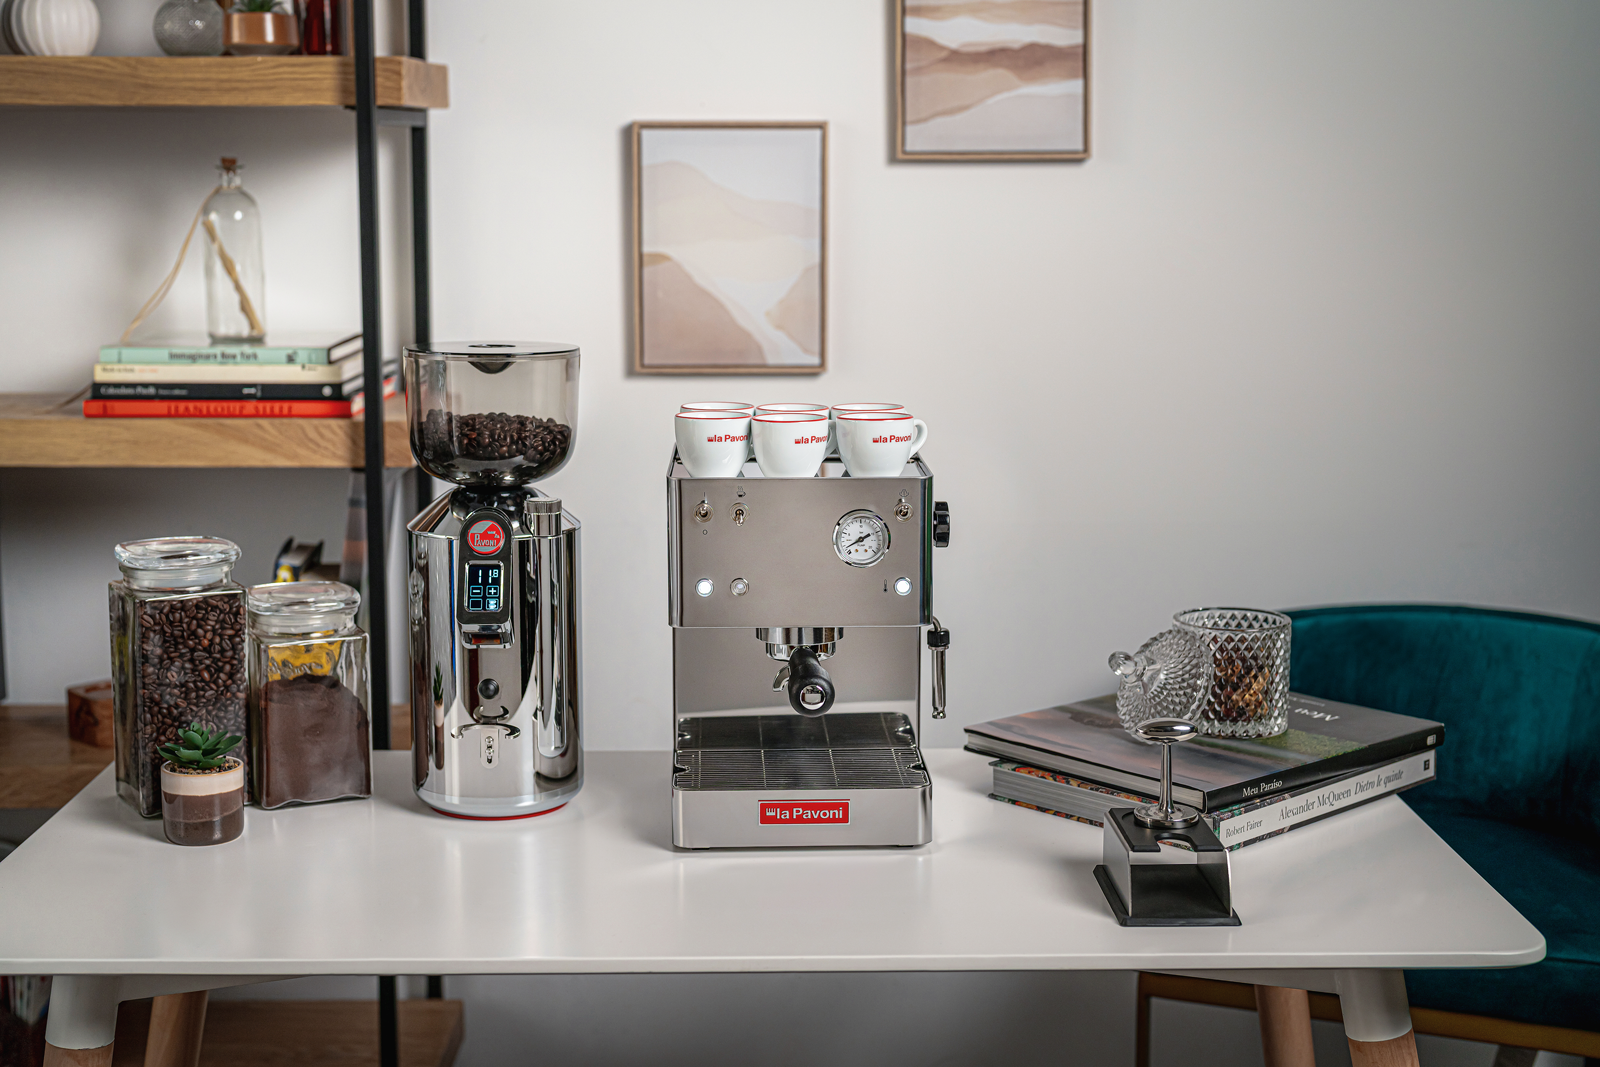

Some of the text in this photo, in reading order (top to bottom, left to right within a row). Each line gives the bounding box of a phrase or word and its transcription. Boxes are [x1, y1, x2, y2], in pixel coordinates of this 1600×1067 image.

[714, 434, 722, 442] la
[801, 436, 809, 444] la
[879, 435, 888, 443] la
[474, 533, 497, 546] PAVONI
[1242, 779, 1283, 798] Meu Paraíso
[1225, 769, 1404, 838] Robert Fairer Alexander McQueen Dietro le quinte
[776, 807, 843, 819] la Pavoni
